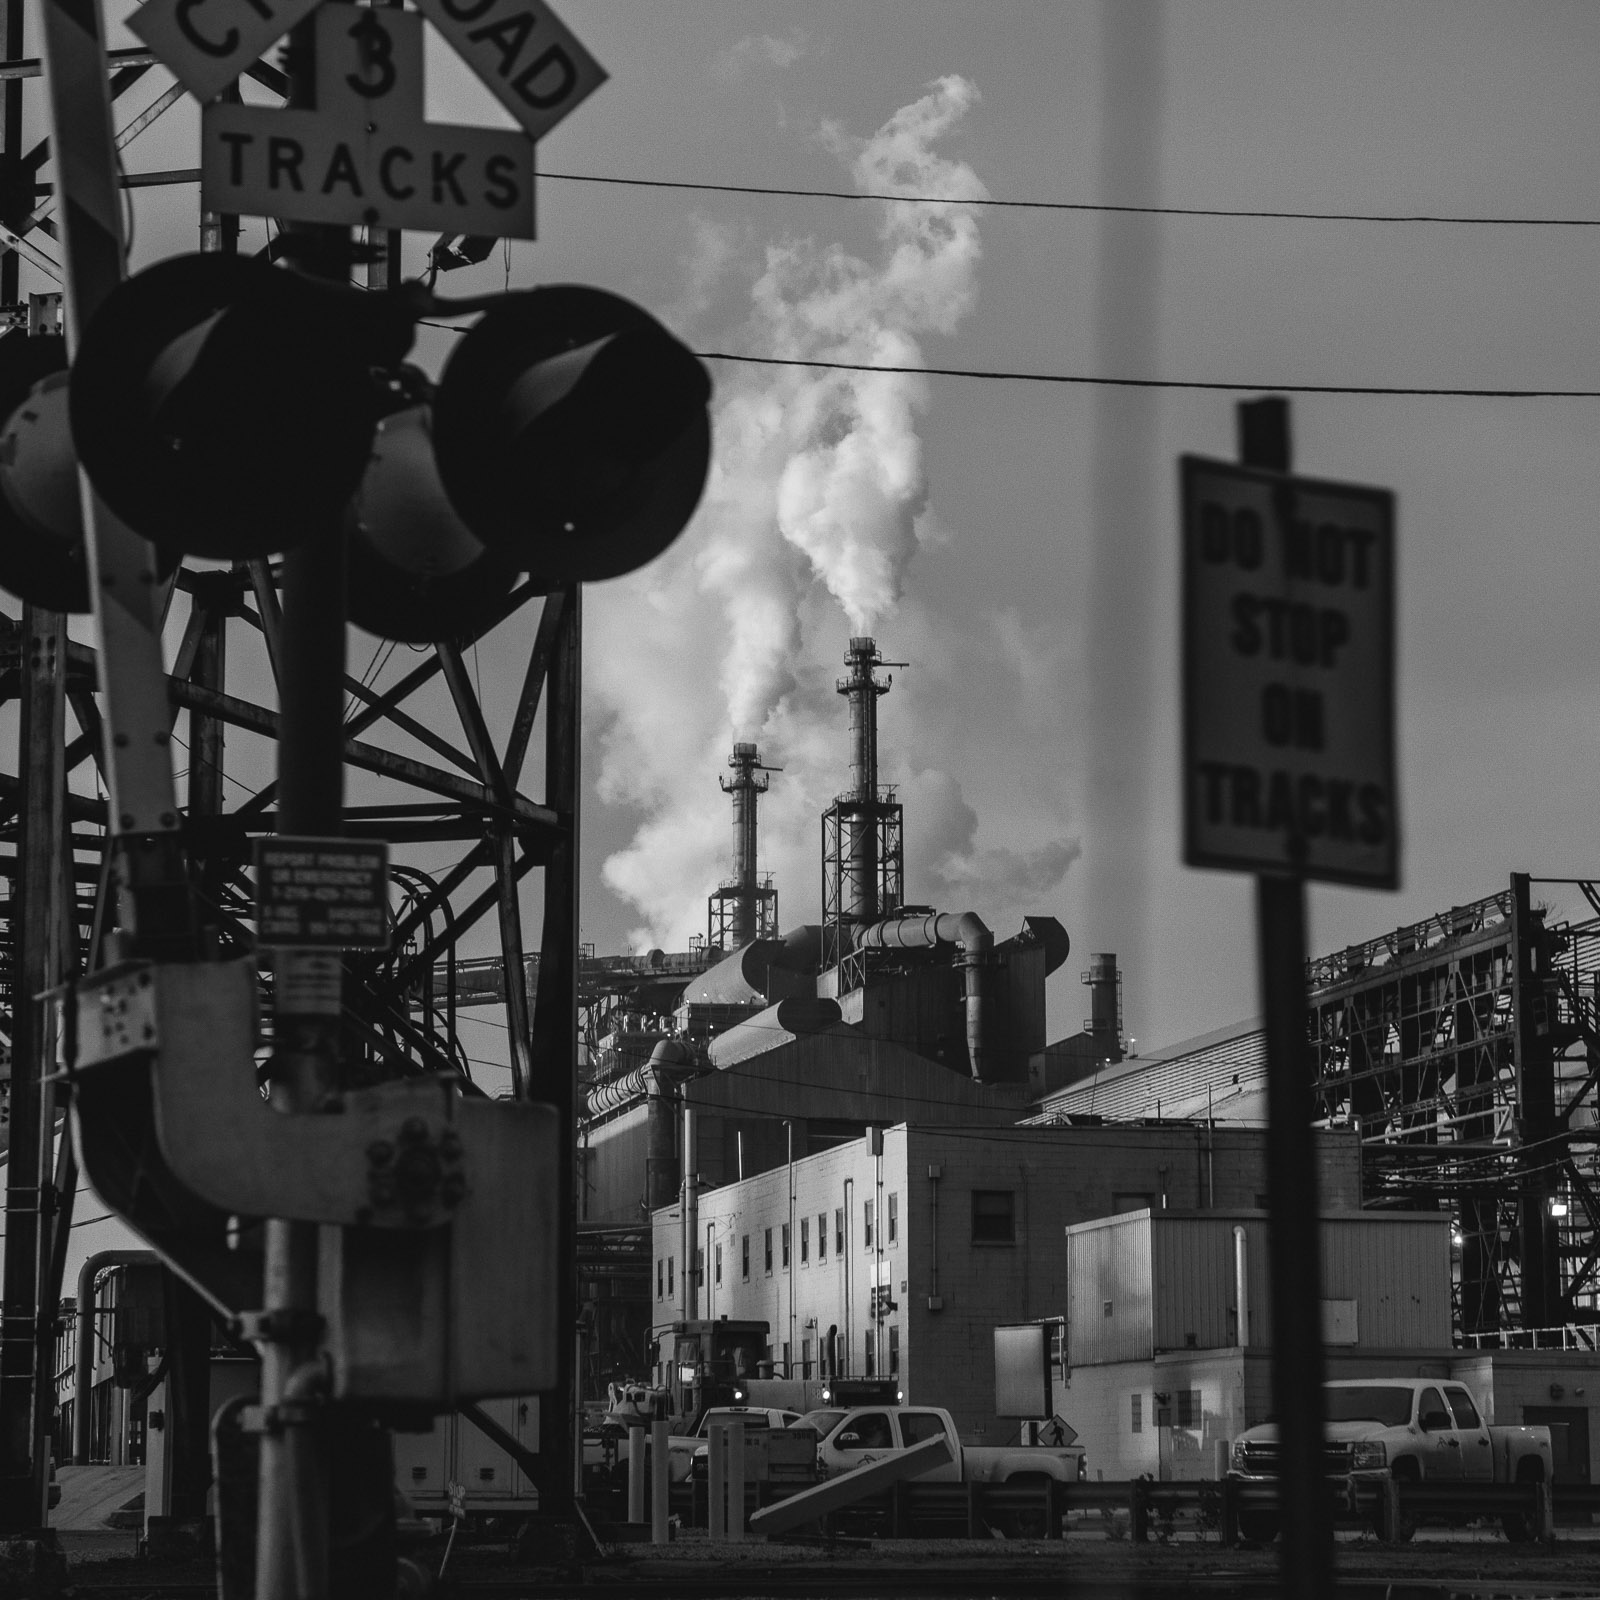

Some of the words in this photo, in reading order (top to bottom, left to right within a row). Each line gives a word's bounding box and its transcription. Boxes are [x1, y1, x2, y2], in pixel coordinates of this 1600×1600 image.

[346, 20, 396, 98] 3
[219, 132, 520, 209] TRACKS
[1201, 500, 1263, 572] DO
[1283, 514, 1376, 591] NOT
[1231, 591, 1350, 669] STOP
[1198, 759, 1386, 846] TRACKS
